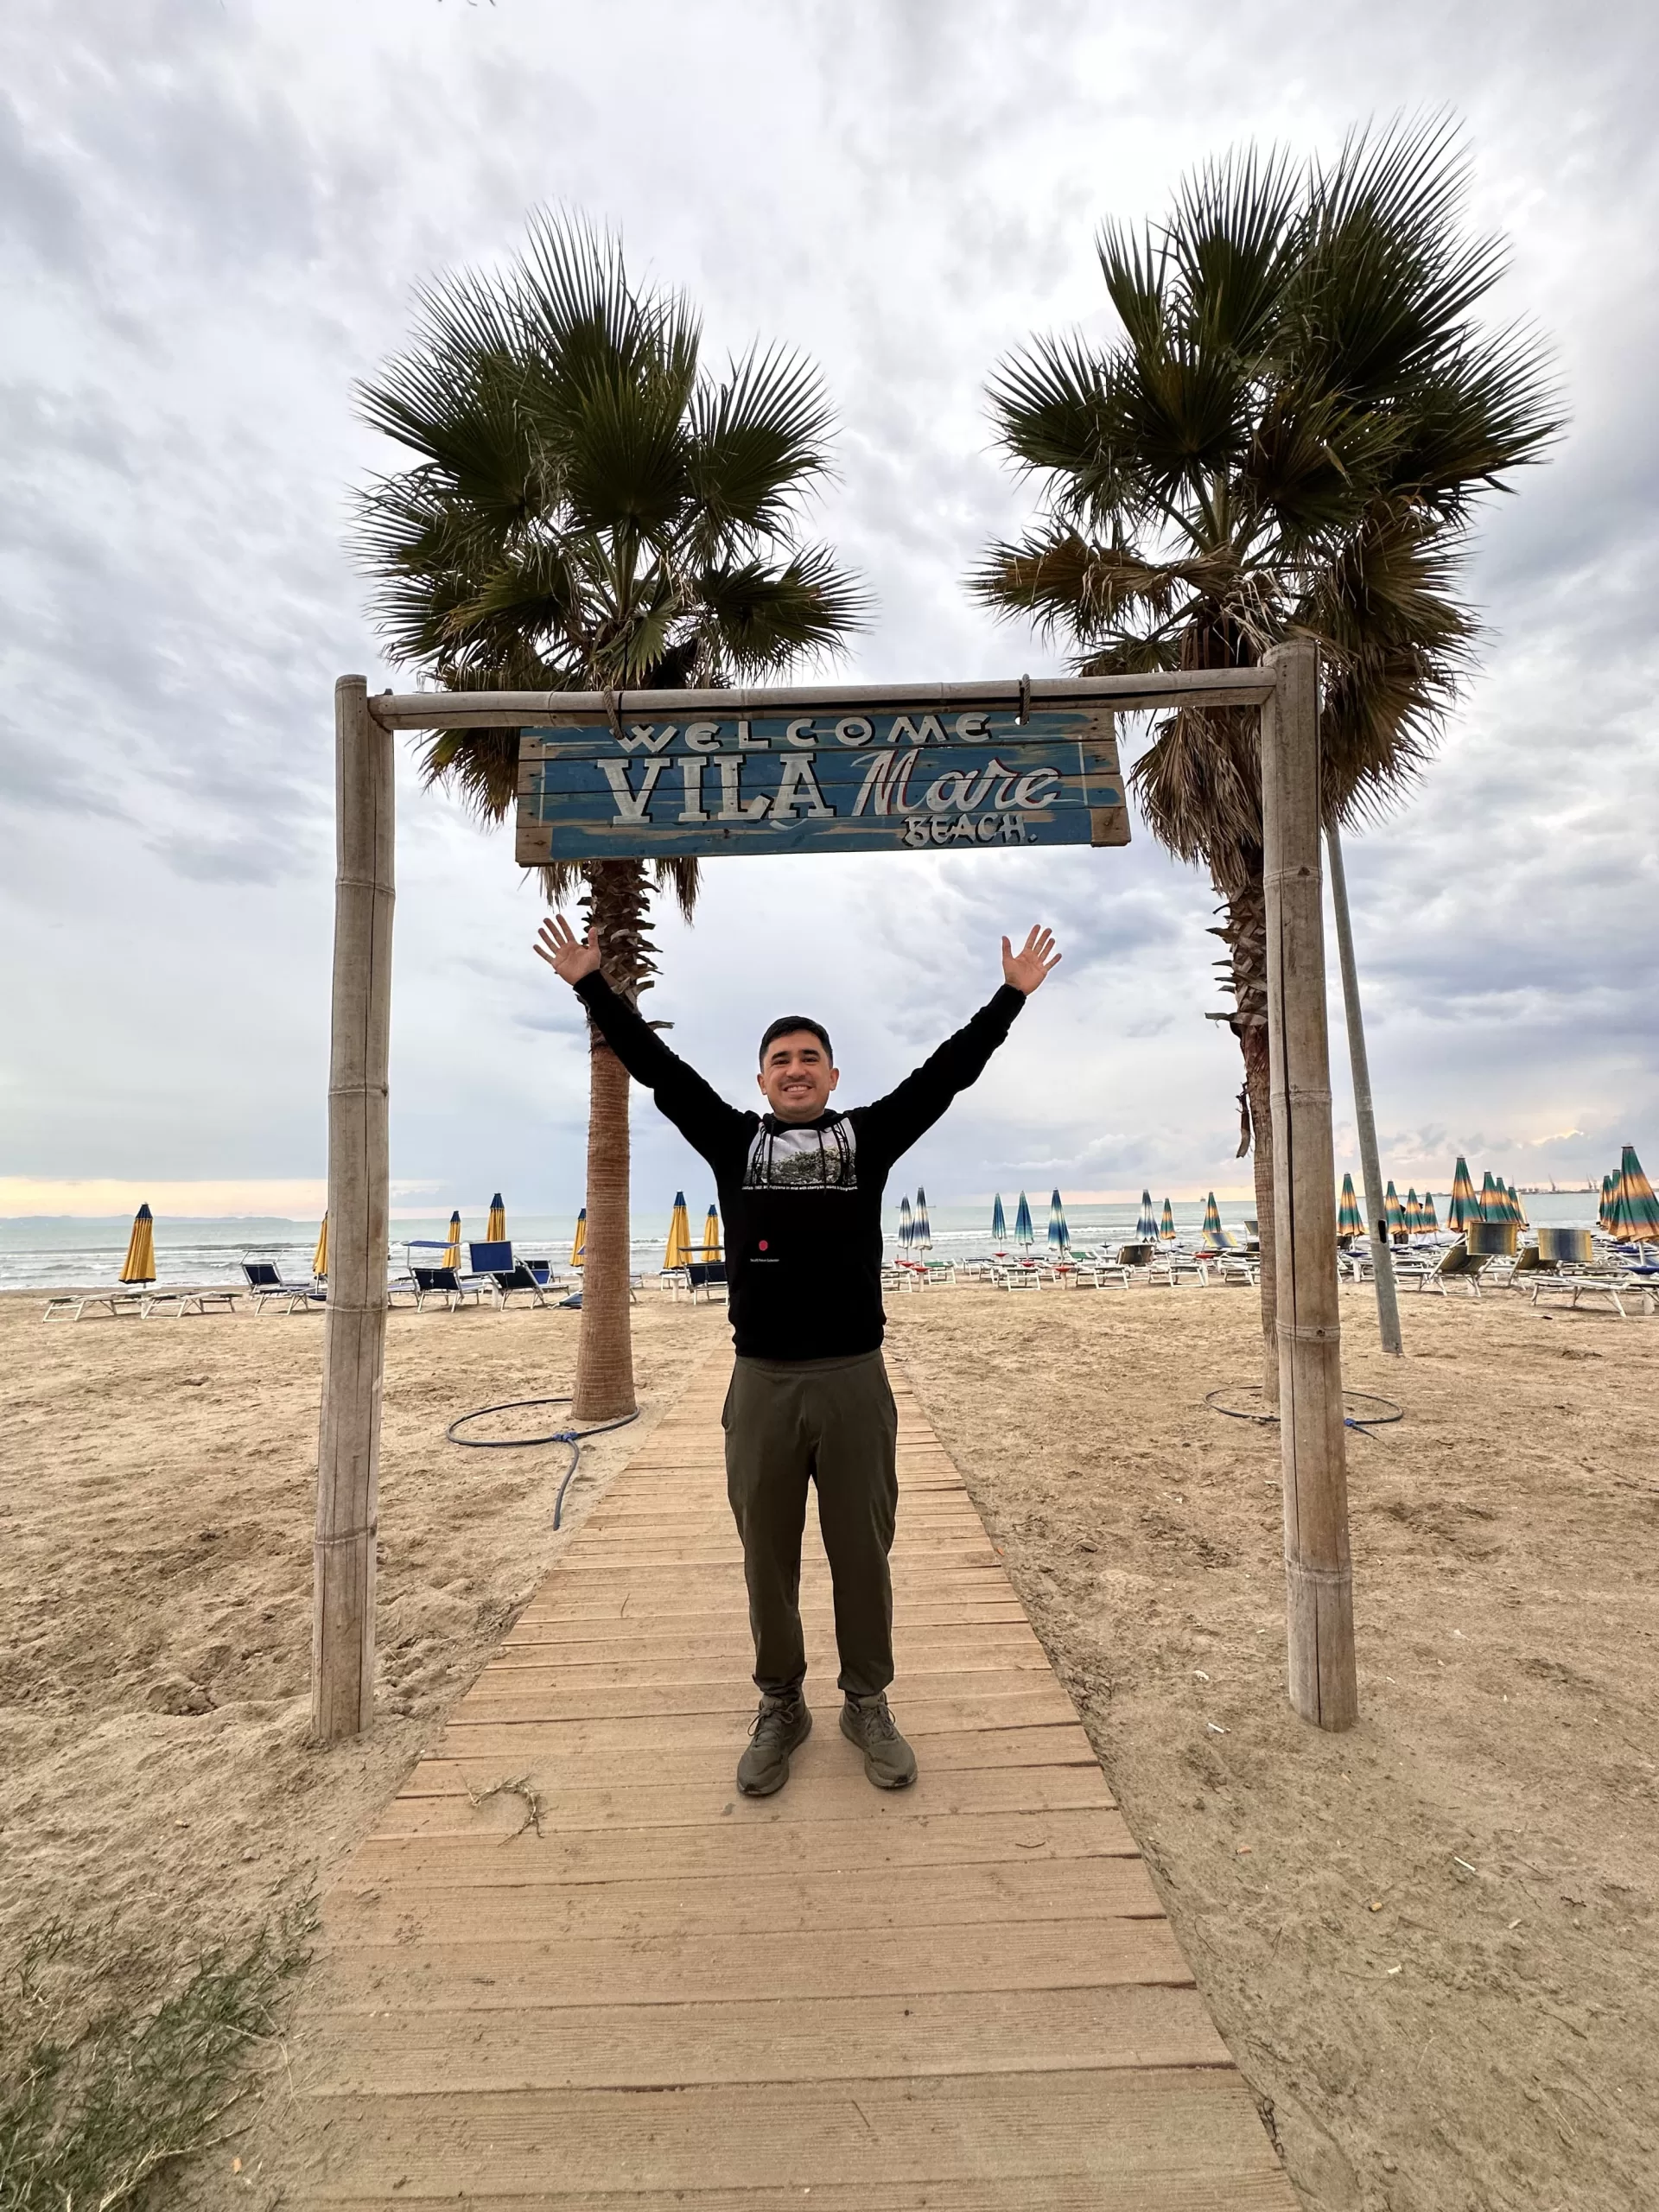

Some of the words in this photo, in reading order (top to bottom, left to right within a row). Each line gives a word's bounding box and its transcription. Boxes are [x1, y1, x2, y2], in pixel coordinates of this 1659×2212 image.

[609, 712, 993, 753] WELCOME
[596, 752, 839, 825] VILA
[851, 748, 1071, 817] Mare
